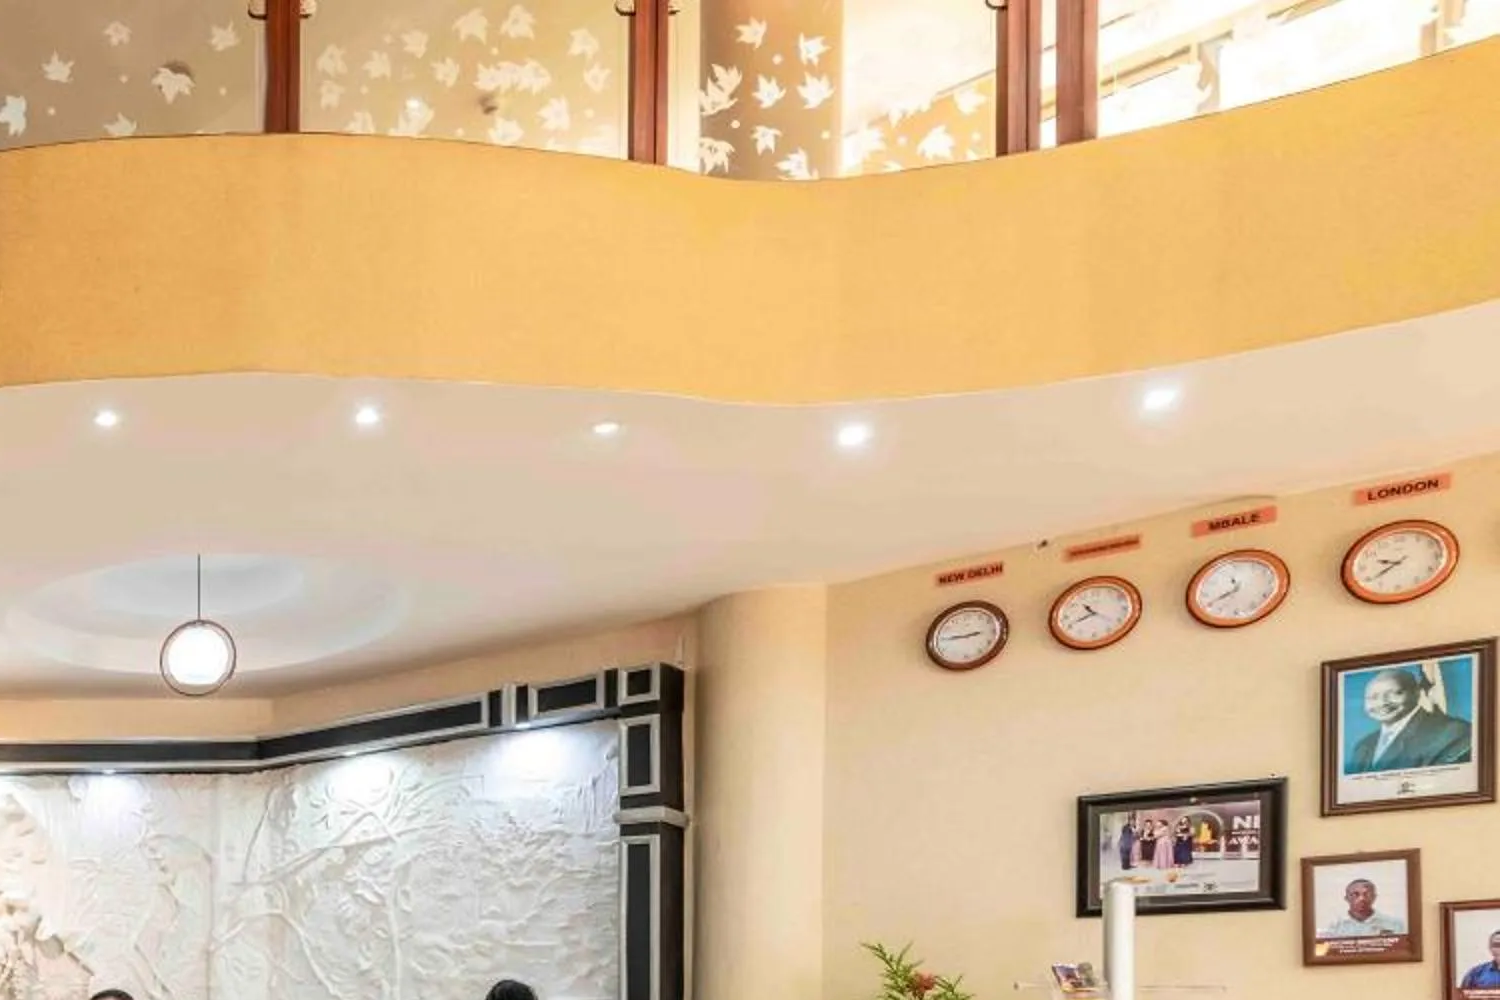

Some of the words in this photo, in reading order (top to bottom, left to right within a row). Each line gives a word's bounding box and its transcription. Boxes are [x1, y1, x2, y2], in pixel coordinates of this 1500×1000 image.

[1367, 479, 1439, 501] LONDON
[1208, 513, 1261, 531] MBALE
[938, 571, 965, 584] NEW
[967, 563, 1003, 579] DELHI
